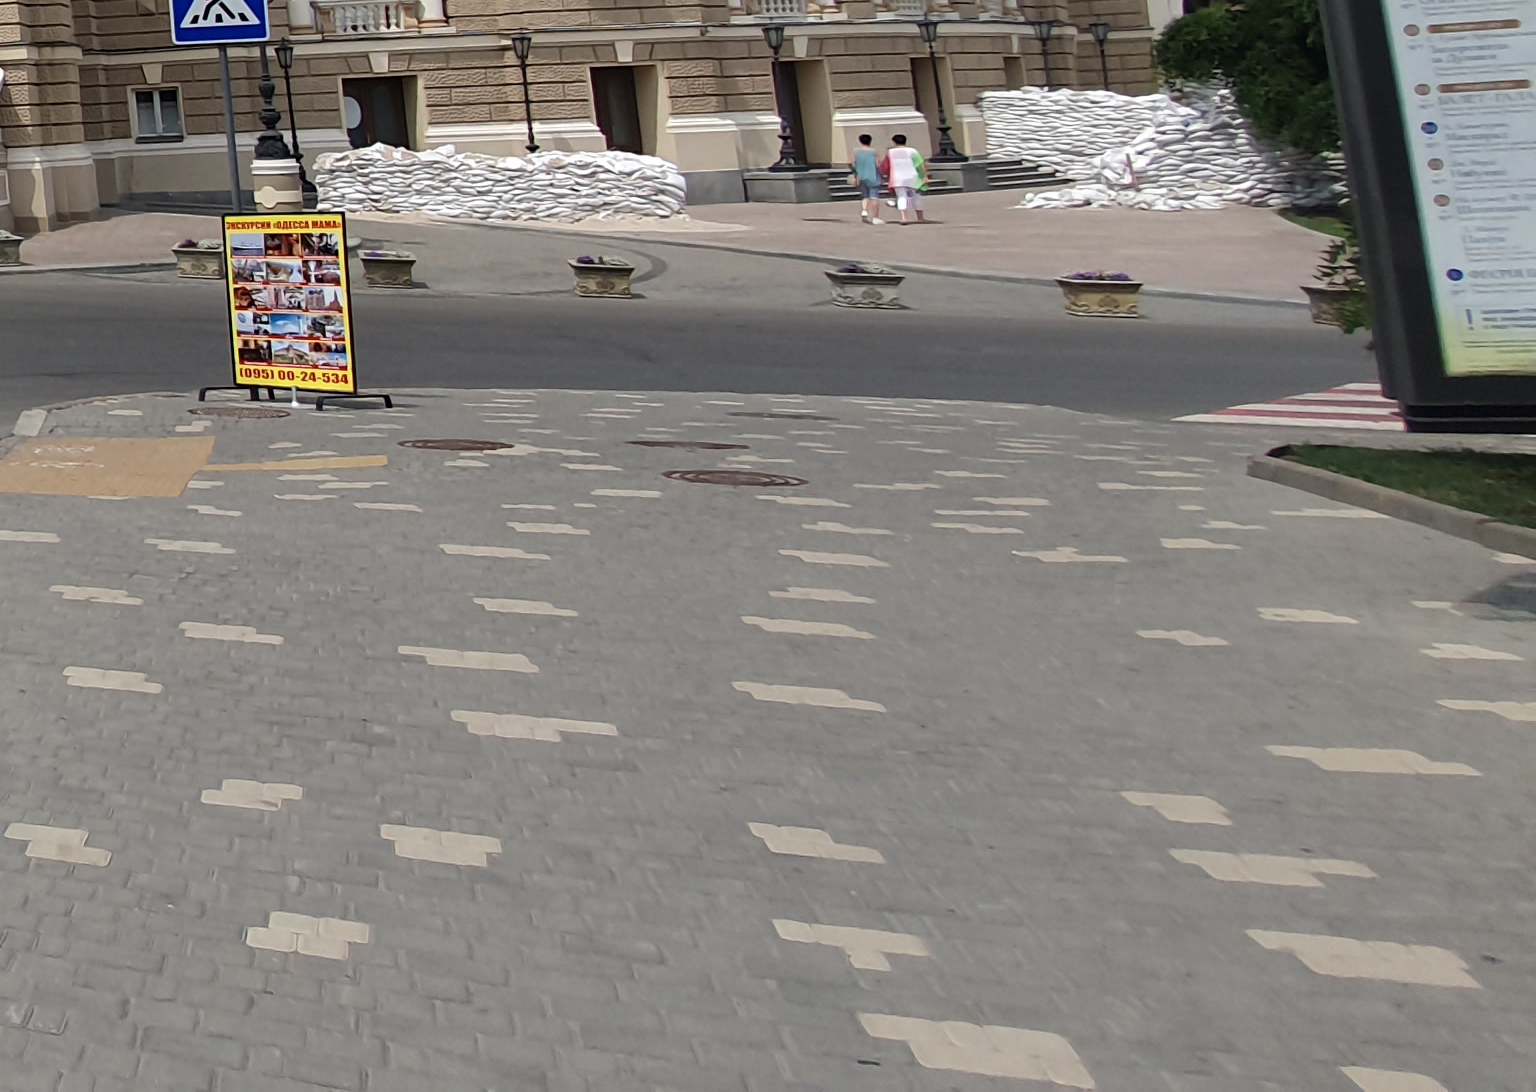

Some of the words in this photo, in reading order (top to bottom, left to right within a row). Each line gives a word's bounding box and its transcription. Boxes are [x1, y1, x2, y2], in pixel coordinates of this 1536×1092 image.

[226, 221, 271, 230] ЭКСКУРСИИ
[239, 367, 275, 380] (095)
[277, 369, 349, 385] 00-24-534
